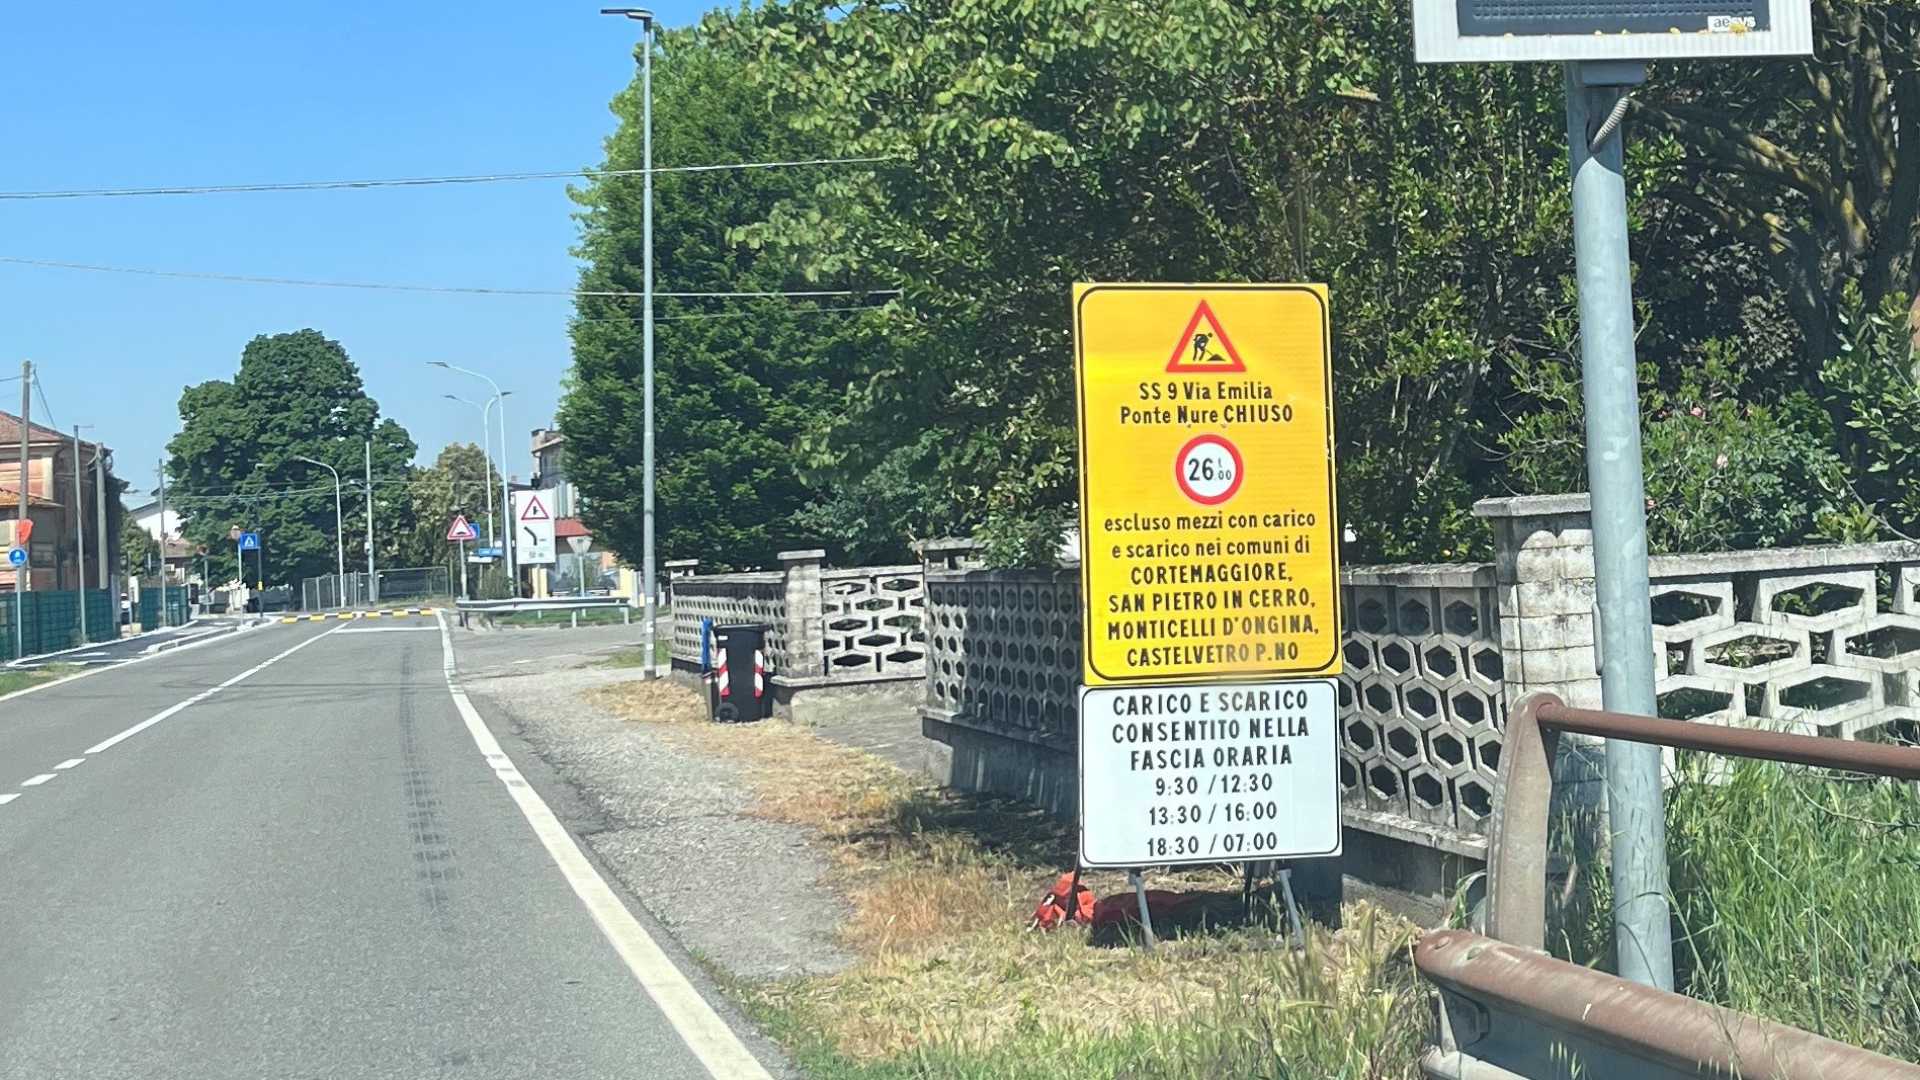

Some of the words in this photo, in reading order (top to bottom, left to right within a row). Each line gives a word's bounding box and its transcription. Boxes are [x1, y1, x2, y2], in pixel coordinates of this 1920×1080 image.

[1140, 382, 1161, 400] SS
[1168, 383, 1177, 400] 9
[1184, 382, 1211, 400] Via
[1219, 381, 1272, 400] Emilia
[1121, 407, 1170, 424] Ponte
[1178, 406, 1218, 424] Nure
[1224, 405, 1292, 422] CHIUSO
[1105, 513, 1170, 531] escluso
[1177, 511, 1222, 530] mezzi
[1229, 513, 1257, 528] con
[1263, 509, 1315, 527] carico
[1112, 545, 1120, 558] e
[1127, 539, 1189, 557] scarico
[1196, 538, 1221, 556] nei
[1227, 536, 1288, 555] comuni
[1295, 535, 1309, 553] di
[1131, 563, 1292, 585] CORTEMAGGIORE,
[1109, 594, 1144, 613] SAN
[1153, 592, 1217, 611] PIETRO
[1224, 591, 1242, 608] IN
[1249, 588, 1315, 608] CERRO,
[1108, 619, 1215, 640] MONTICELLI
[1127, 644, 1249, 666] CASTELVETRO
[1113, 692, 1191, 715] CARICO
[1201, 693, 1210, 713] E
[1219, 690, 1307, 712] SCARICO
[1112, 720, 1240, 743] CONSENTITO
[1249, 717, 1309, 738] NELLA
[1131, 748, 1205, 771] FASCIA
[1214, 745, 1292, 767] ORARIA
[1156, 776, 1198, 796] 9:30
[1222, 773, 1272, 794] 12:30
[1149, 805, 1201, 826] 13:30
[1225, 801, 1277, 822] 16:00
[1147, 836, 1199, 856] 18:30
[1223, 832, 1277, 852] 07:00
